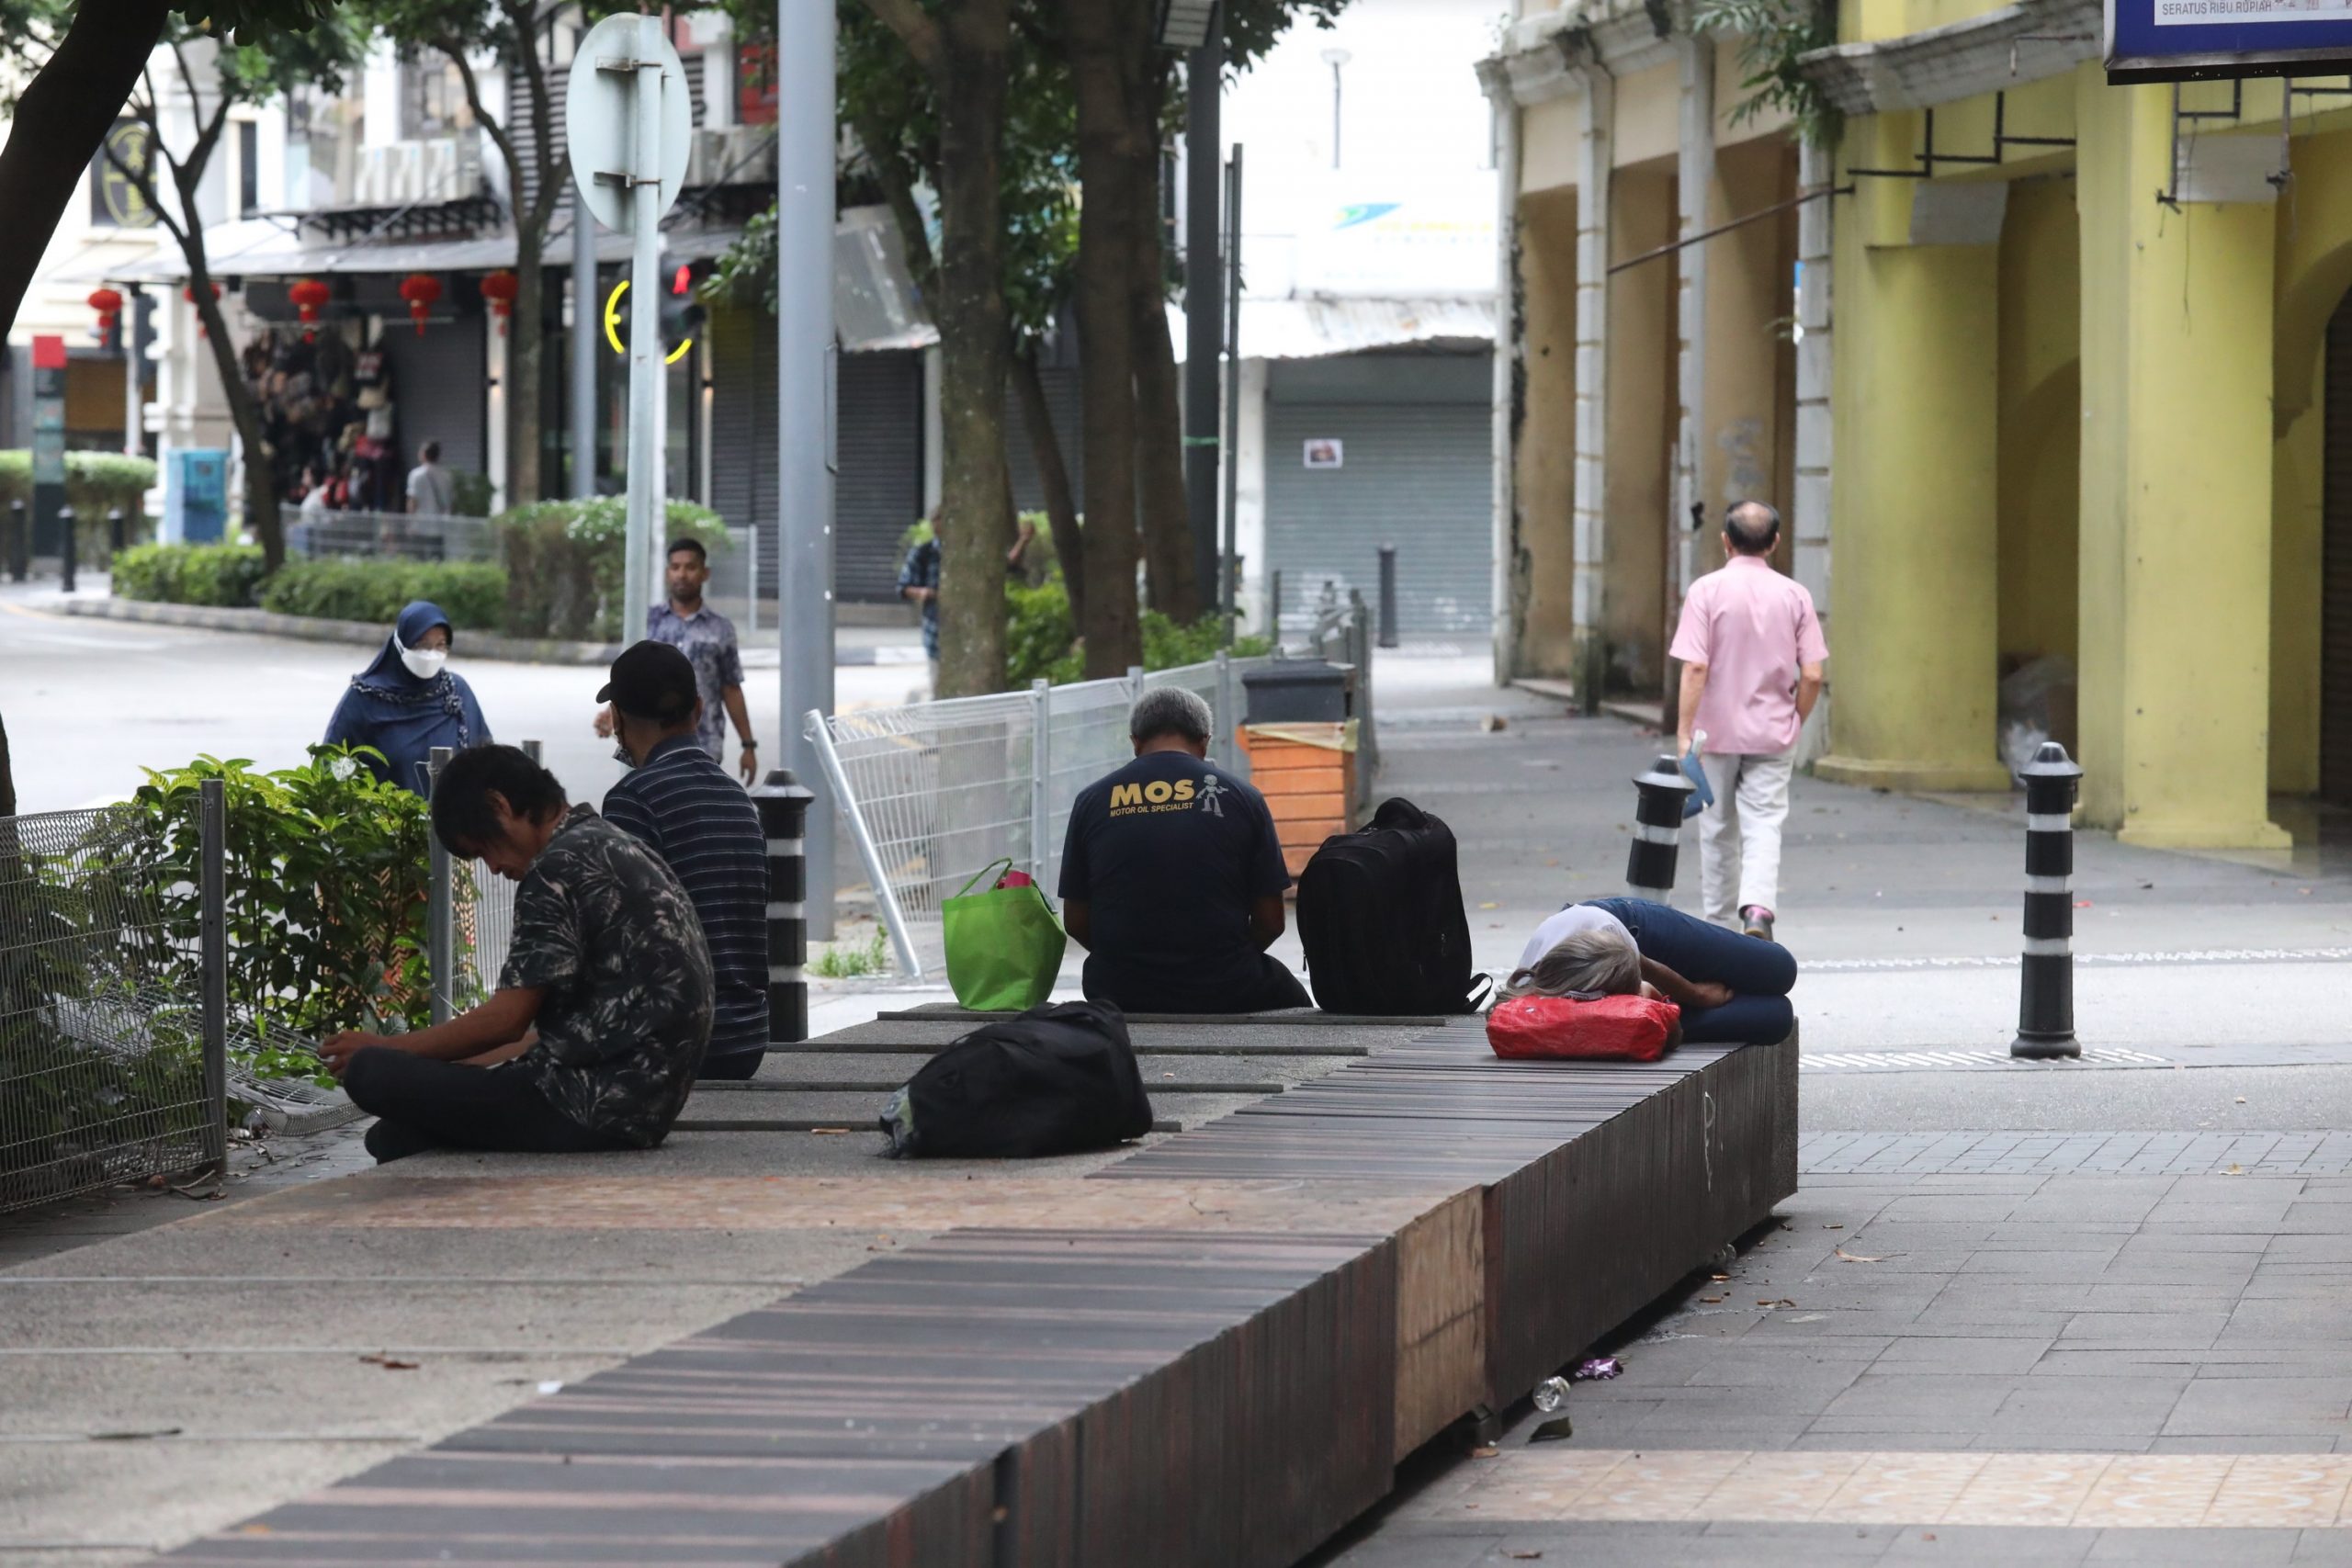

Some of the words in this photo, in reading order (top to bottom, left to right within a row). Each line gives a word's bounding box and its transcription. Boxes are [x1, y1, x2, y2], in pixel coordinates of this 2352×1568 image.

[2162, 2, 2207, 16] SERATUS
[2210, 2, 2233, 14] RIBU
[2236, 1, 2272, 13] RUPIAH
[1110, 779, 1194, 808] MOS
[1110, 806, 1136, 818] MOTOR
[1137, 805, 1149, 813] OIL
[1151, 802, 1194, 813] SPECIALIST
